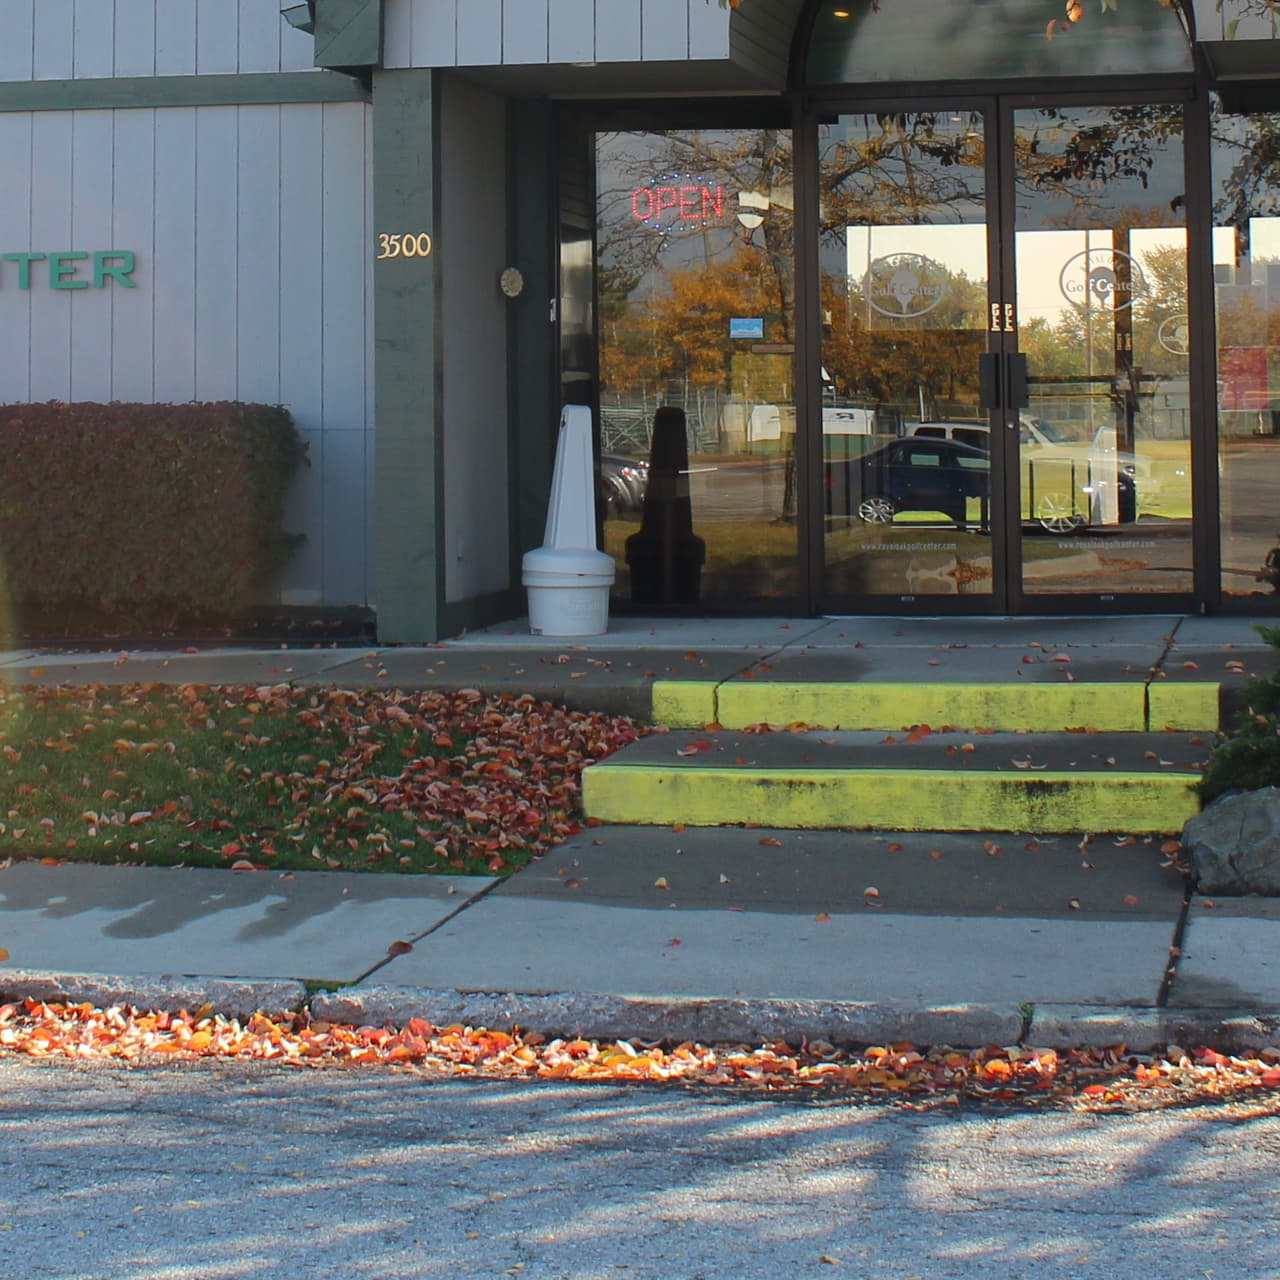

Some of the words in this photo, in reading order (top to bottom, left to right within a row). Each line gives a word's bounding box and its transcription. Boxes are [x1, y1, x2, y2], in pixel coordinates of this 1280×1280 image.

[631, 186, 724, 220] OPEN
[376, 232, 432, 259] 3500
[1065, 278, 1095, 292] Gof
